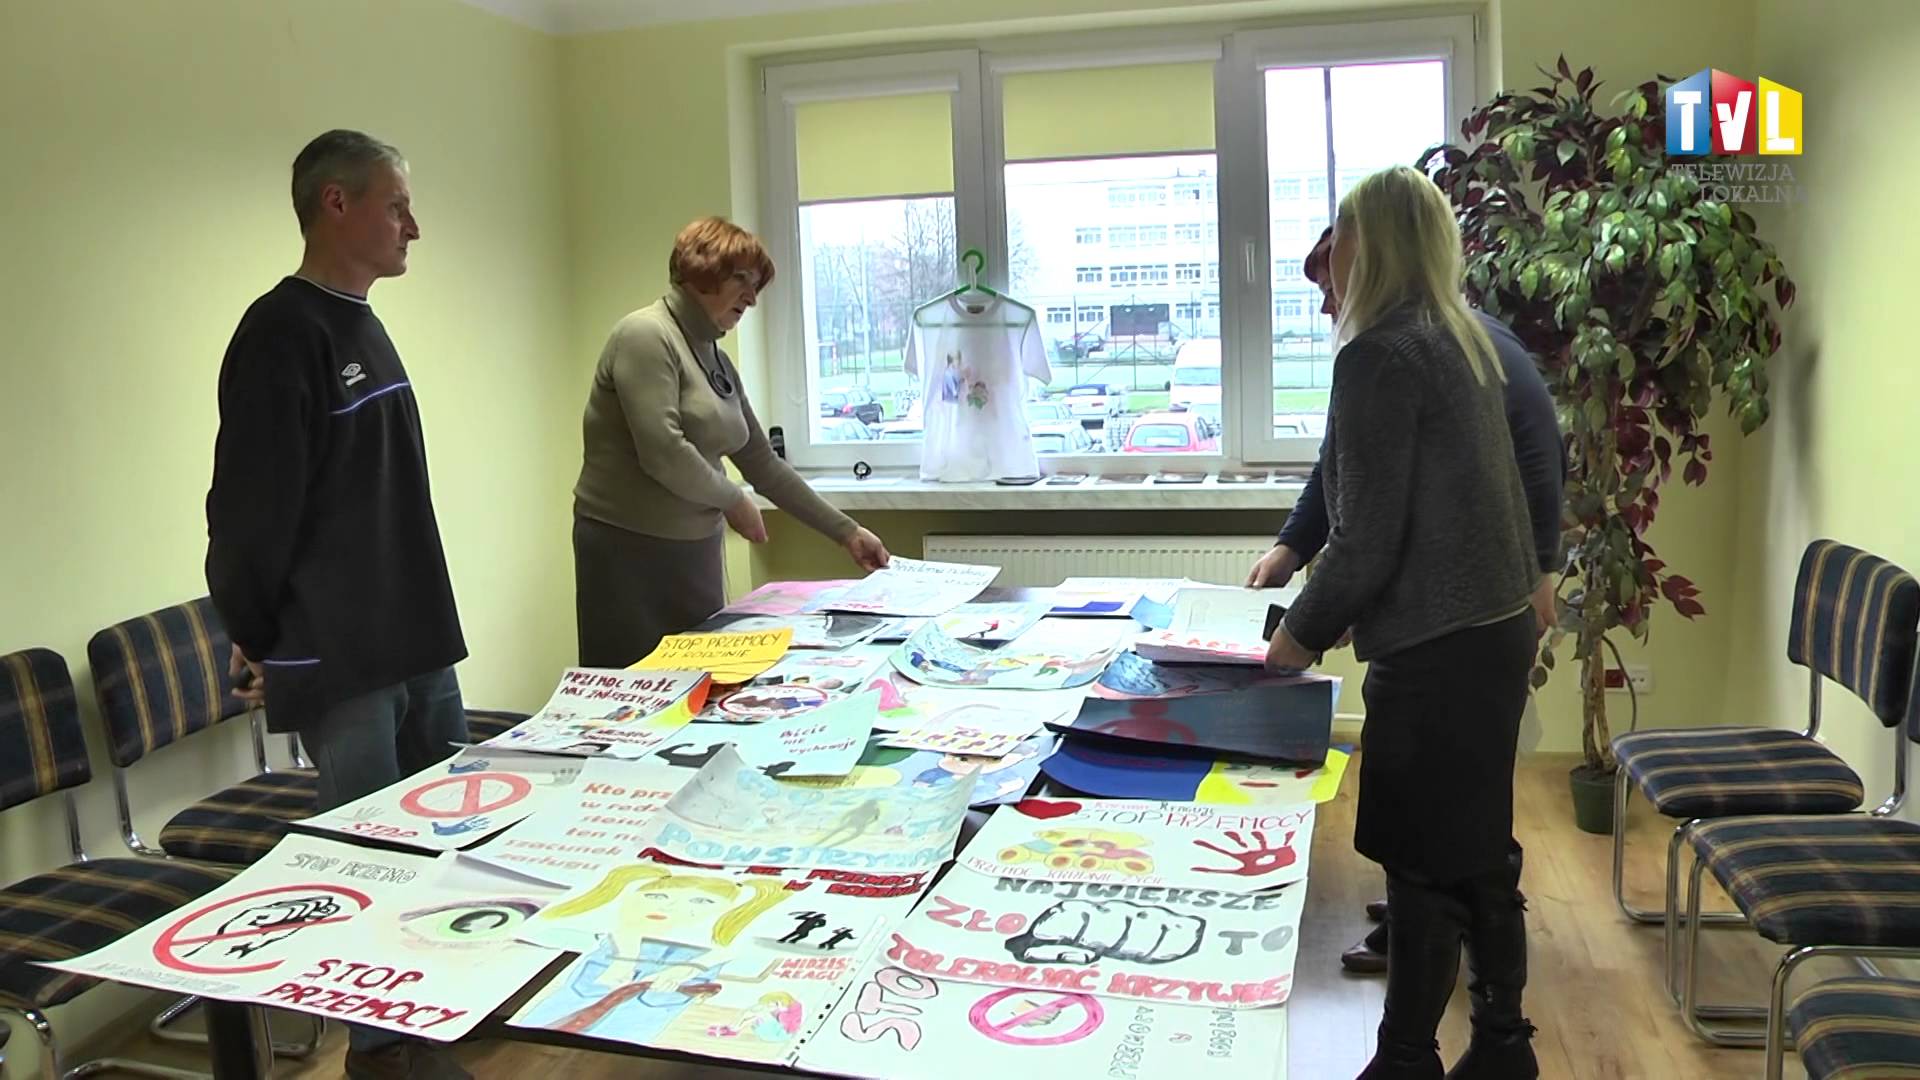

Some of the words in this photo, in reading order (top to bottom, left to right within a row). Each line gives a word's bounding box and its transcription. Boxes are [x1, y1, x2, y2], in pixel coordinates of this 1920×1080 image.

[607, 803, 663, 812] rodz
[630, 788, 672, 799] prz
[925, 895, 1027, 935] ZŁO
[1217, 925, 1293, 956] TO
[302, 958, 424, 991] STOP
[260, 982, 468, 1029] PRZEMOCY
[840, 965, 940, 1051] STO
